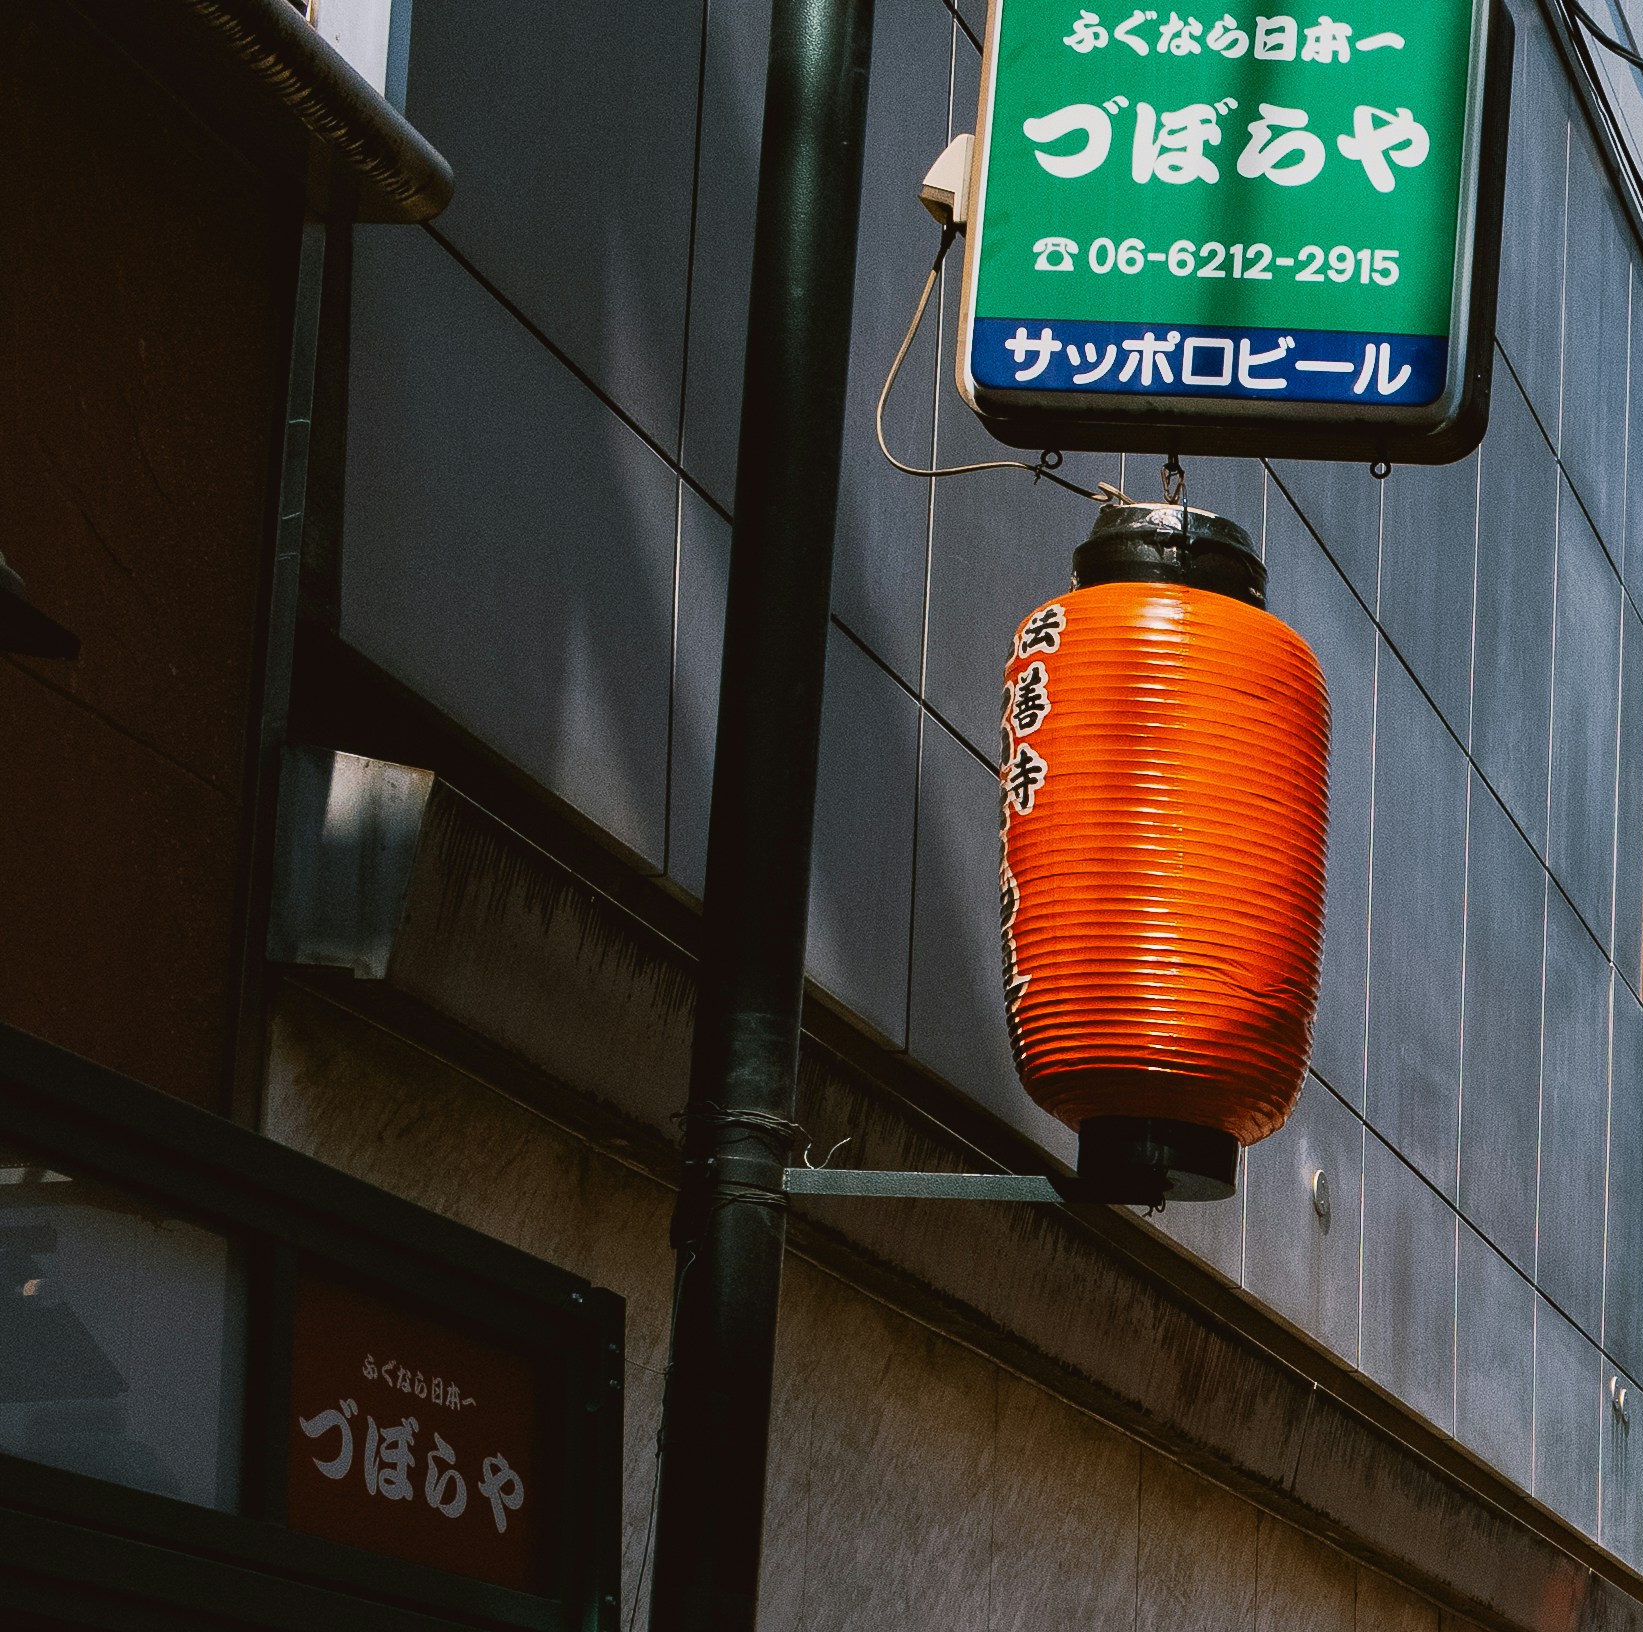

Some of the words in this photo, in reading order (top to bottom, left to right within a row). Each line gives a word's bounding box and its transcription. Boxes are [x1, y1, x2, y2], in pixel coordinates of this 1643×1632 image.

[1063, 9, 1405, 64] ふぐなら日本一
[1023, 95, 1430, 192] づぼらや
[1089, 237, 1399, 287] 06-6212-2915
[1004, 326, 1412, 396] サッポロビール
[362, 1352, 477, 1411] ふぐなら日本一
[300, 1398, 525, 1534] づぼらや
